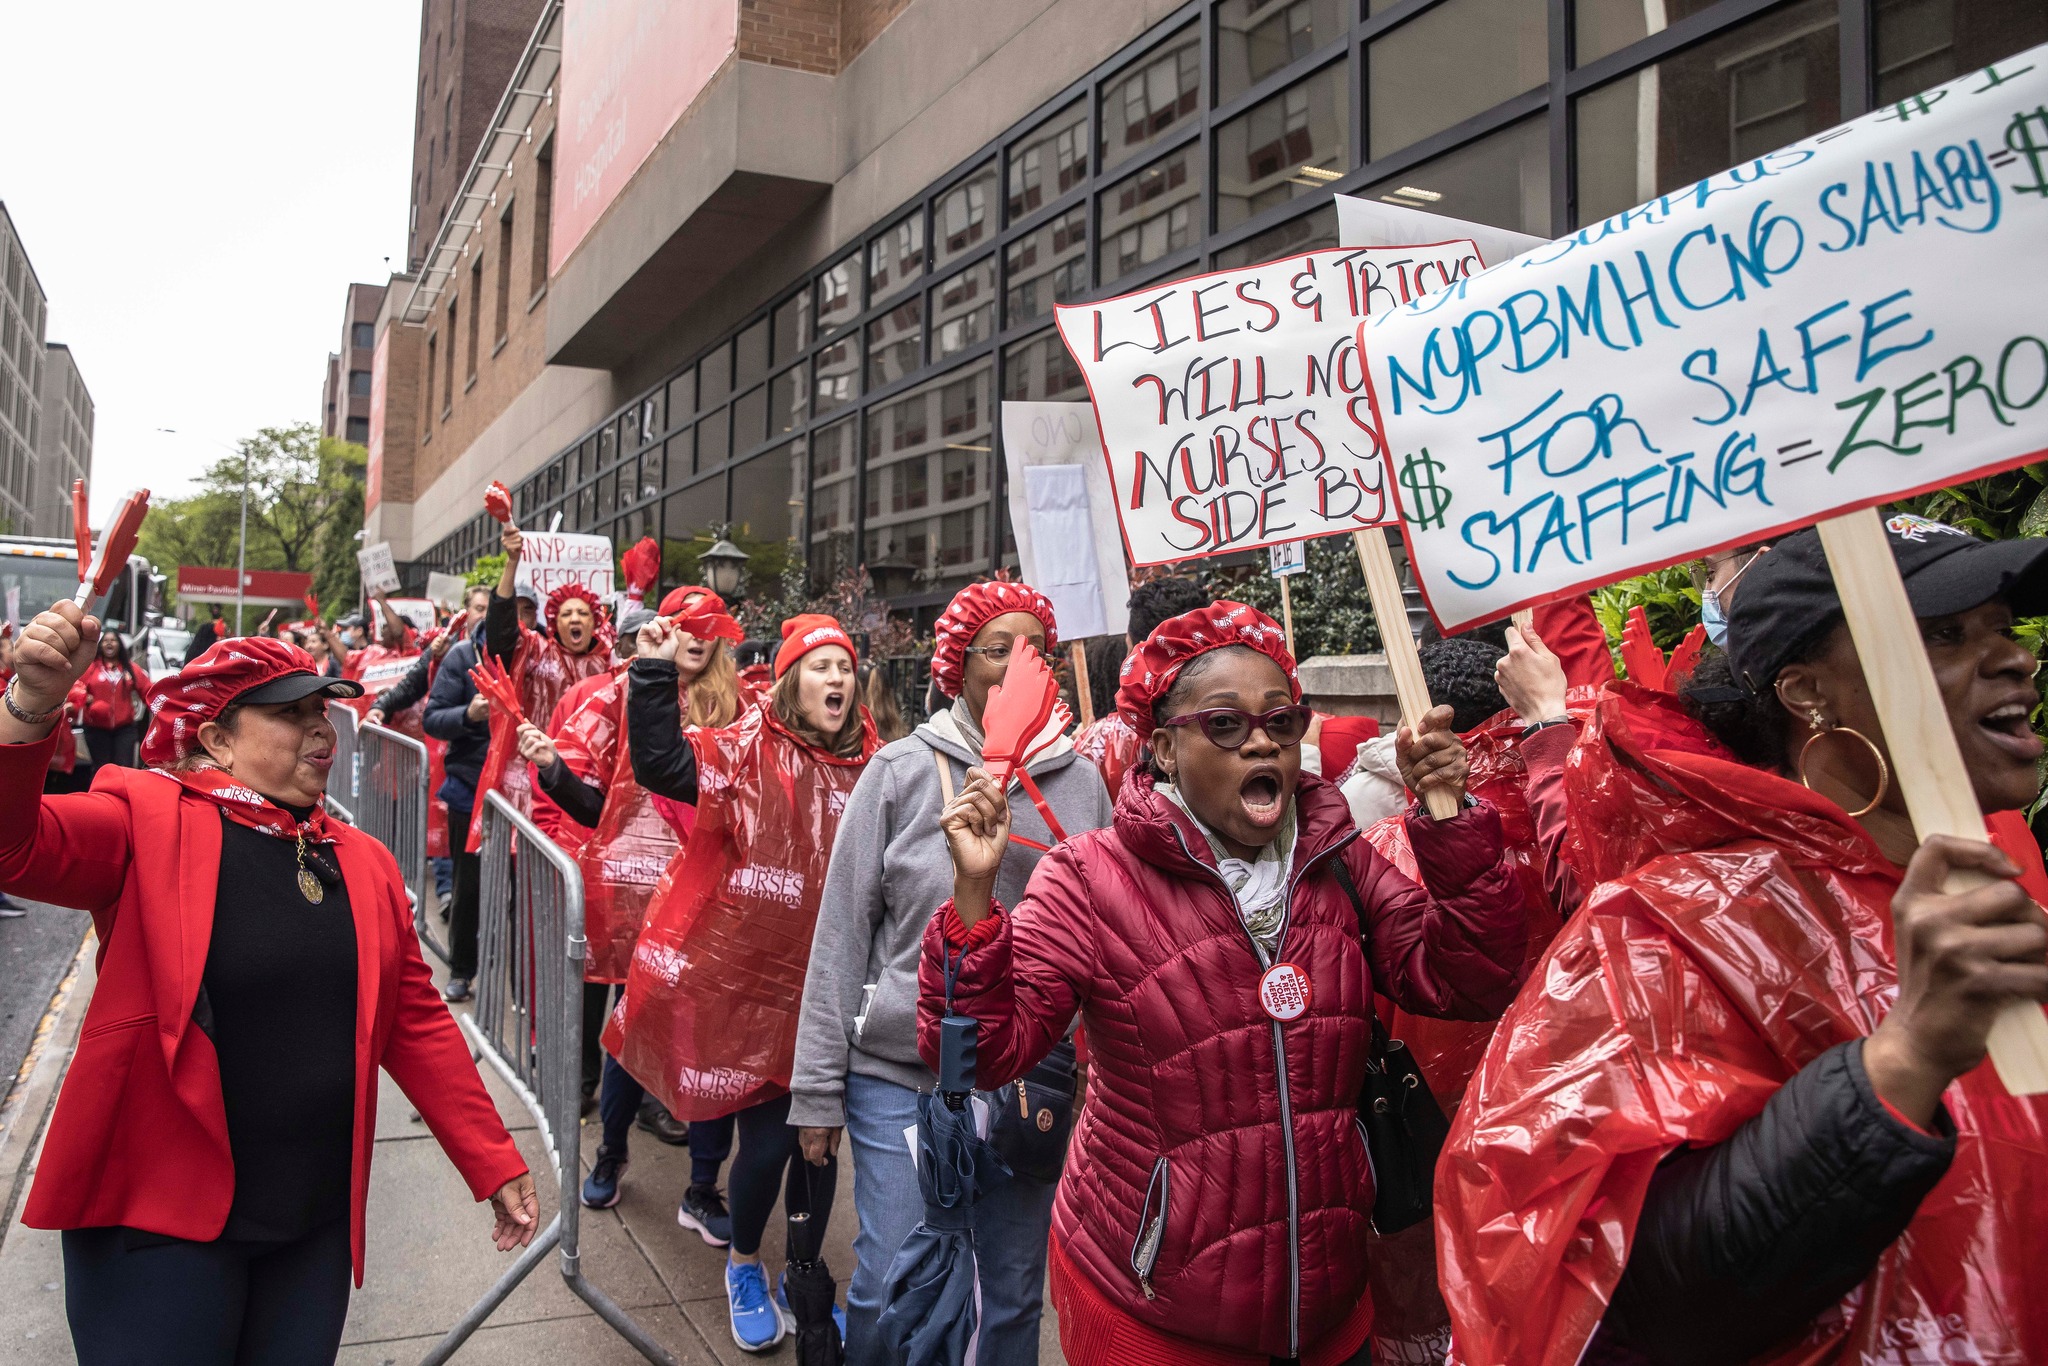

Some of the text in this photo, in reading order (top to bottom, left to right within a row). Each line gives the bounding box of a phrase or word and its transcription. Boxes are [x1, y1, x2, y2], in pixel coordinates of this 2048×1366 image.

[1093, 279, 1280, 363] LIES
[1290, 257, 1323, 323] &
[1132, 355, 1294, 426] WILL
[1478, 289, 1935, 497] FOR SAFE
[1130, 408, 1328, 510] NURSES
[1445, 429, 1775, 593] STAFFING
[1826, 335, 2048, 476] ZERO
[1161, 461, 1387, 554] SIDE BY
[531, 567, 615, 596] RESPECT
[729, 868, 805, 898] NURSES
[750, 862, 769, 873] New
[769, 865, 786, 877] York
[1267, 981, 1283, 1013] HEROES
[1274, 982, 1288, 1006] YOUR
[1282, 982, 1297, 1011] RETAIN
[1286, 973, 1302, 1006] RESPECT
[710, 1066, 730, 1078] New
